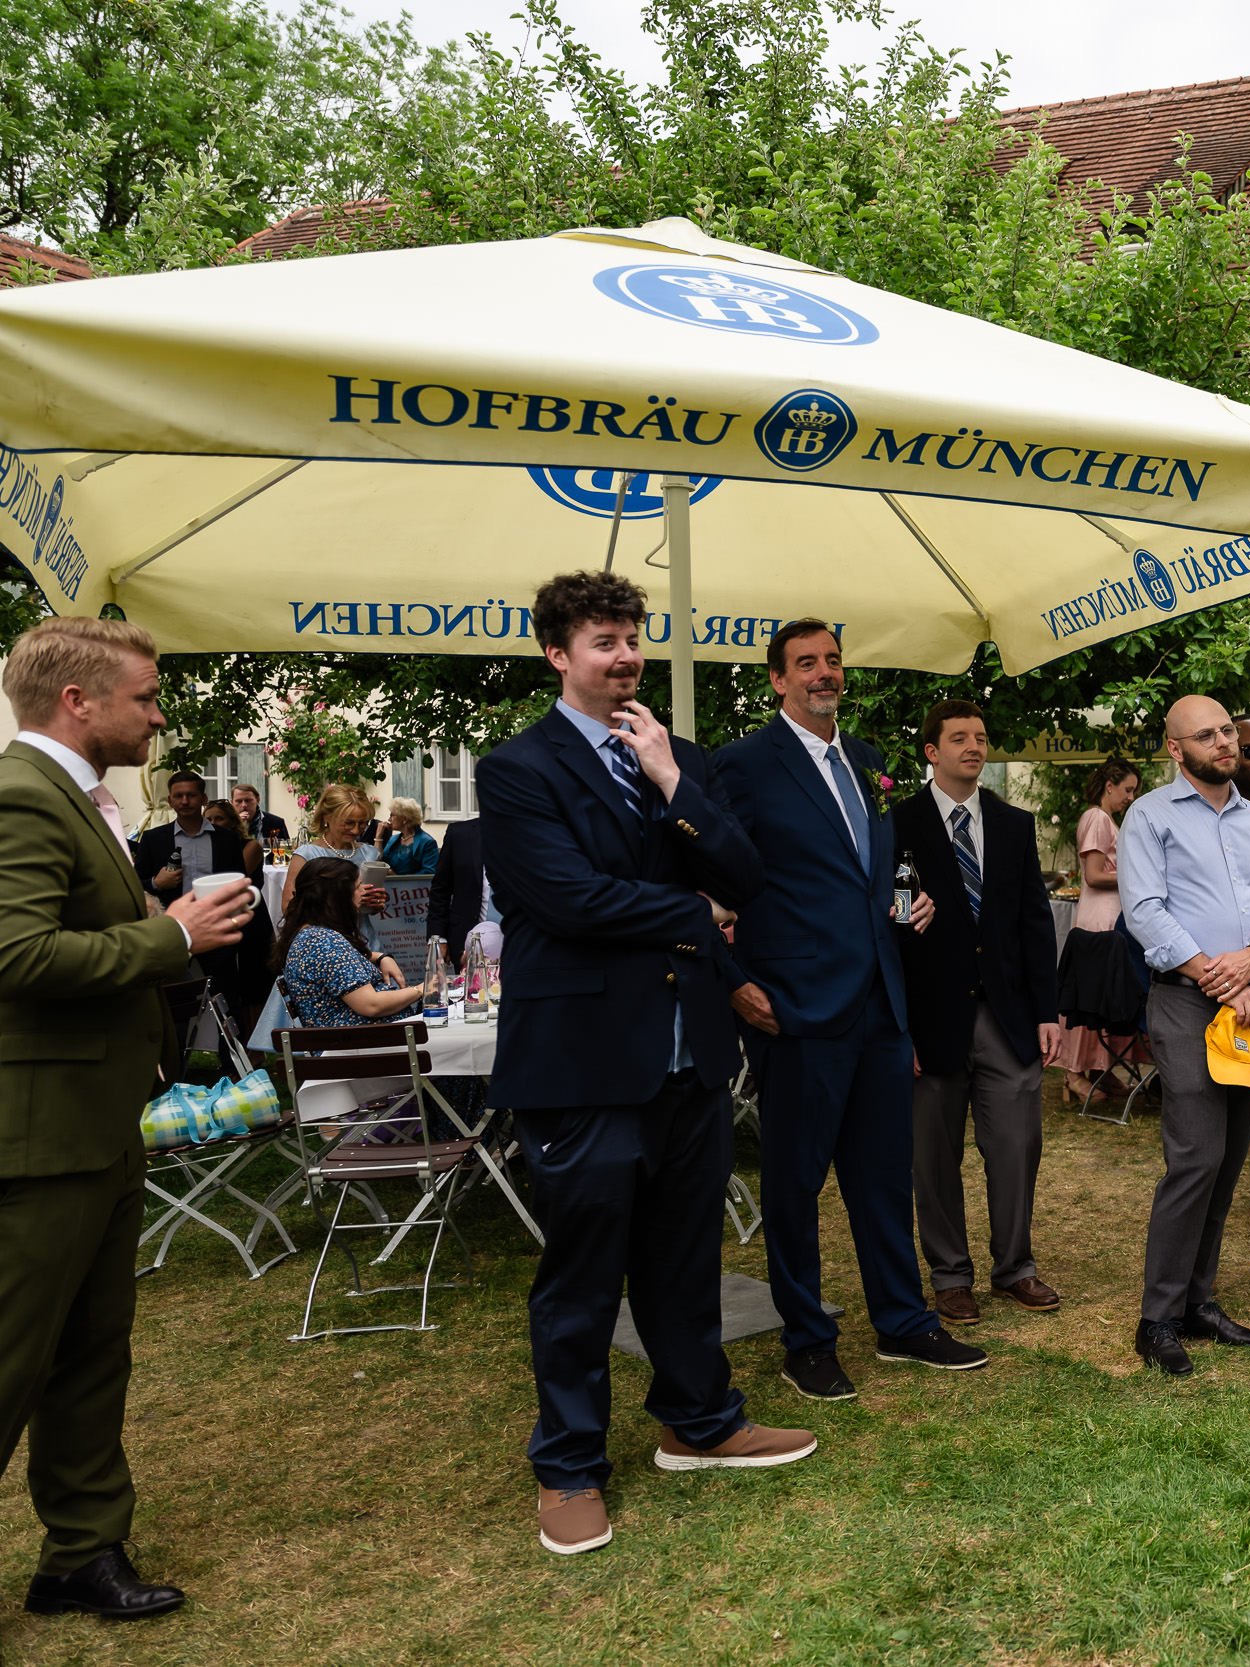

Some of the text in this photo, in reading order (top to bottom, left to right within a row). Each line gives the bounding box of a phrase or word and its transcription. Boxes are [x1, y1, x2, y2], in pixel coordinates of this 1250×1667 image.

[680, 294, 823, 334] HB
[329, 375, 1217, 501] HOFBRÄU HB MÜNCHEN
